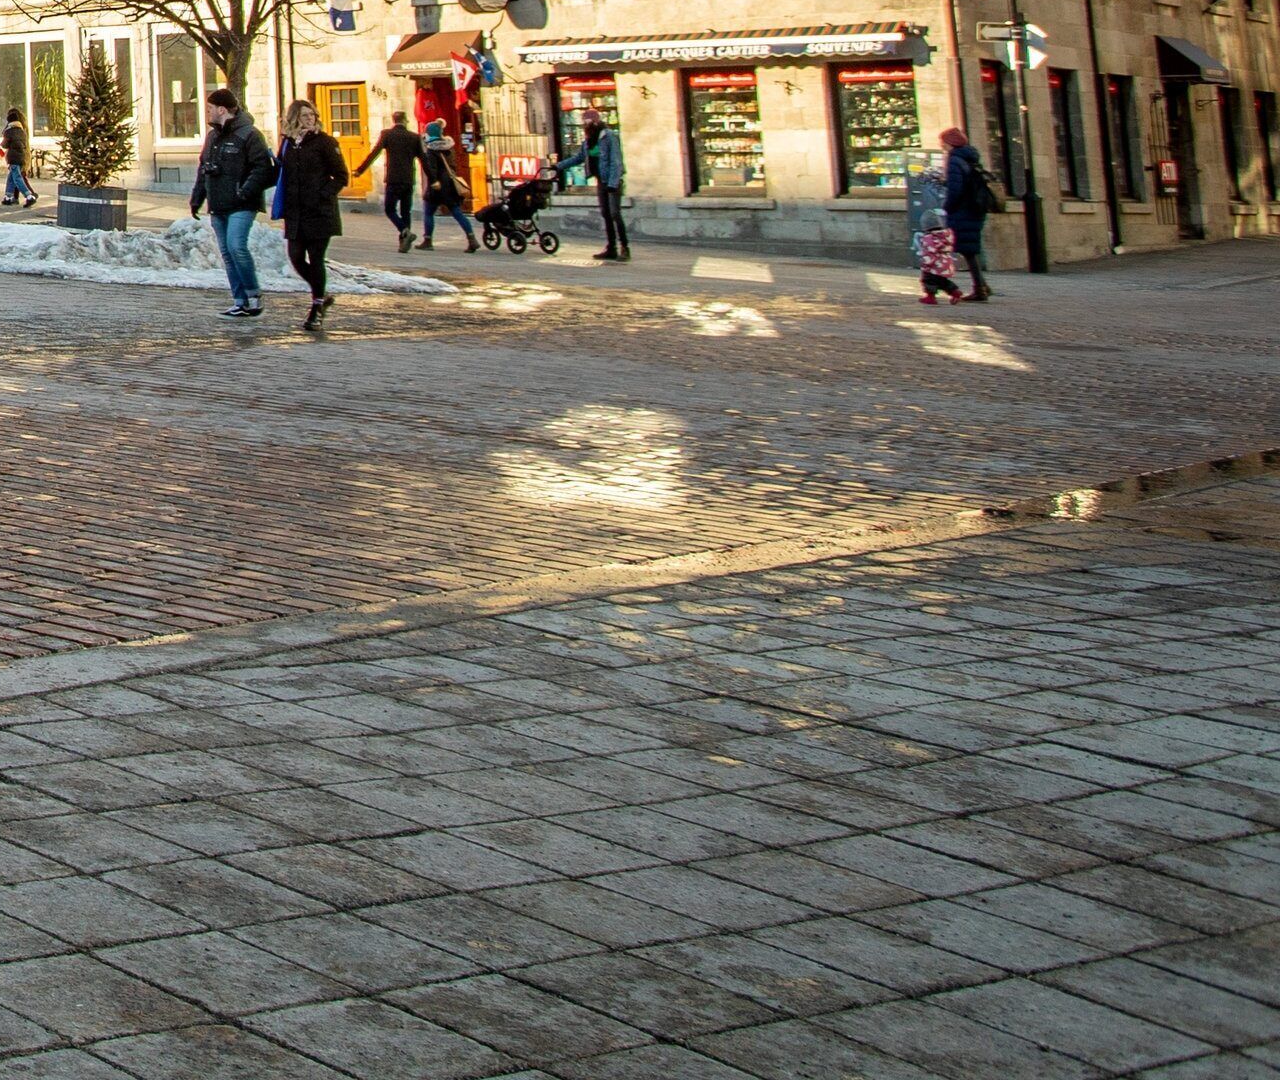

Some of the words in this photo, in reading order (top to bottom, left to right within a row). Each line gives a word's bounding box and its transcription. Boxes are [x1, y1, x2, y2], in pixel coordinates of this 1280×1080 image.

[525, 52, 589, 62] SOUVENIRS
[623, 48, 660, 60] PLACE
[661, 46, 714, 59] JACQUES
[716, 45, 770, 56] CARTIER
[806, 41, 883, 53] SOUVENIRS
[401, 62, 446, 70] SOUVENIRS
[371, 84, 387, 100] 403
[501, 157, 537, 175] ATM
